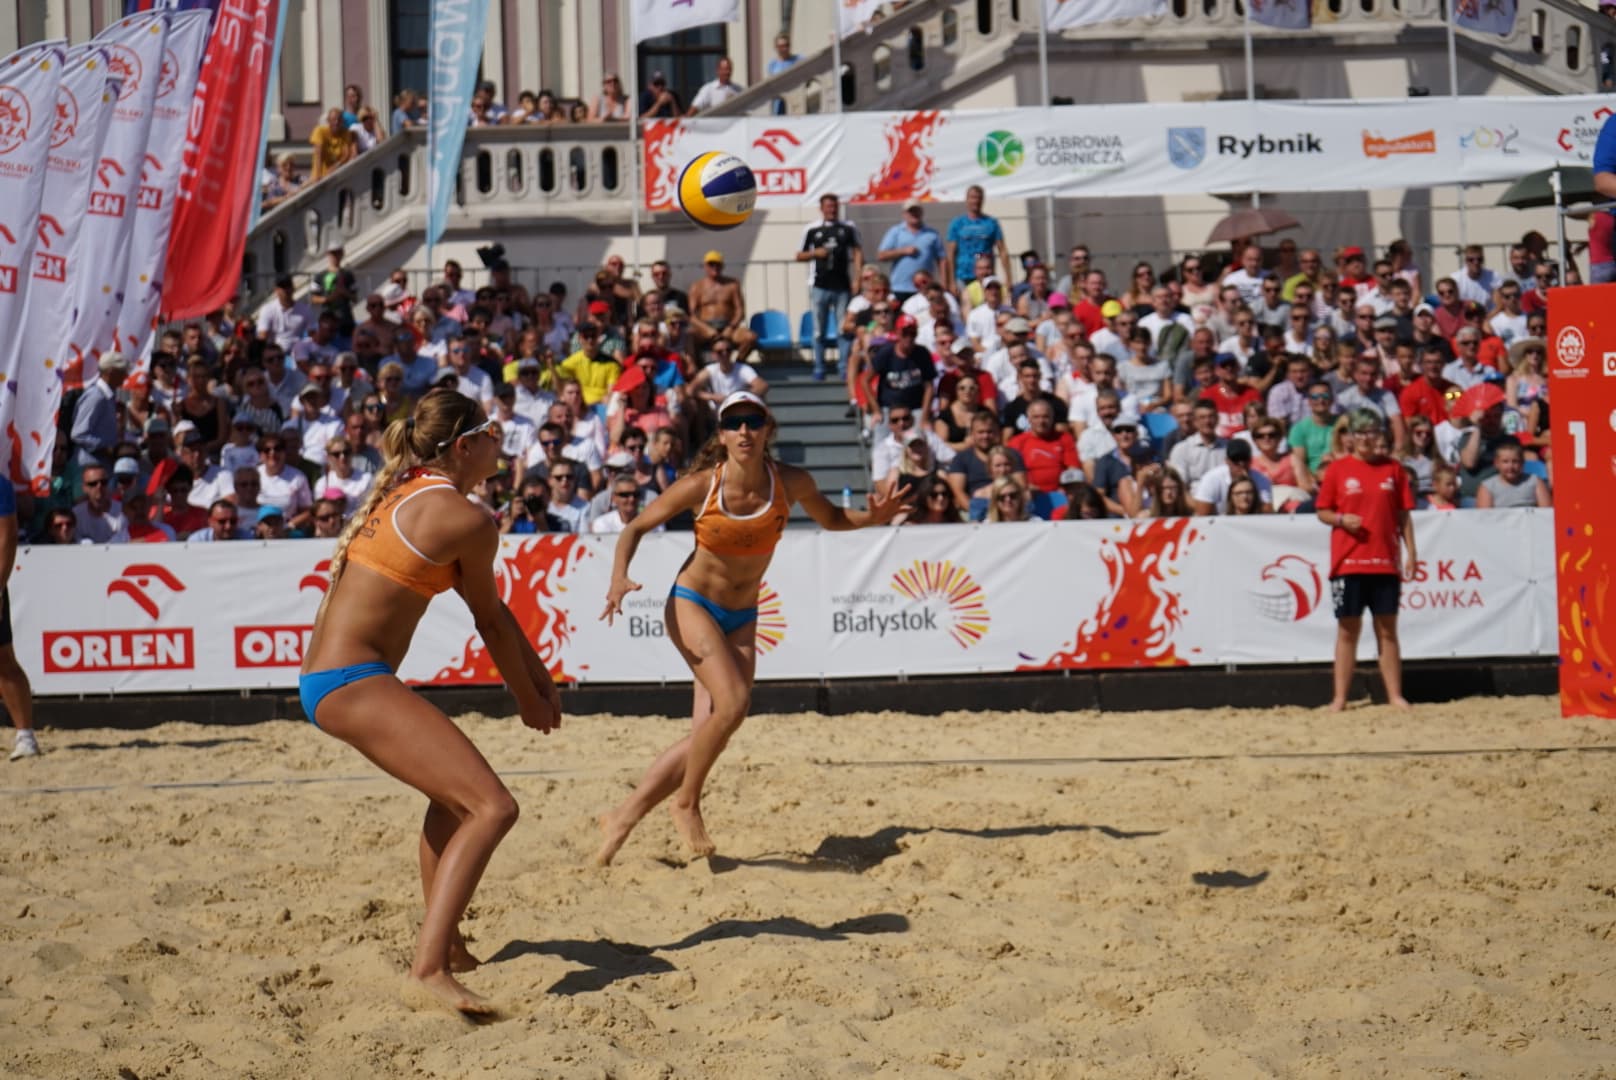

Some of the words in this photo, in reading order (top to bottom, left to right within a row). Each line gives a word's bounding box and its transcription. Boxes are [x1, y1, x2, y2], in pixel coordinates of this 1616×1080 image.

[1218, 133, 1323, 158] Rybnik
[1568, 421, 1587, 469] 1
[833, 606, 938, 637] Białystok
[50, 632, 185, 669] ORLEN
